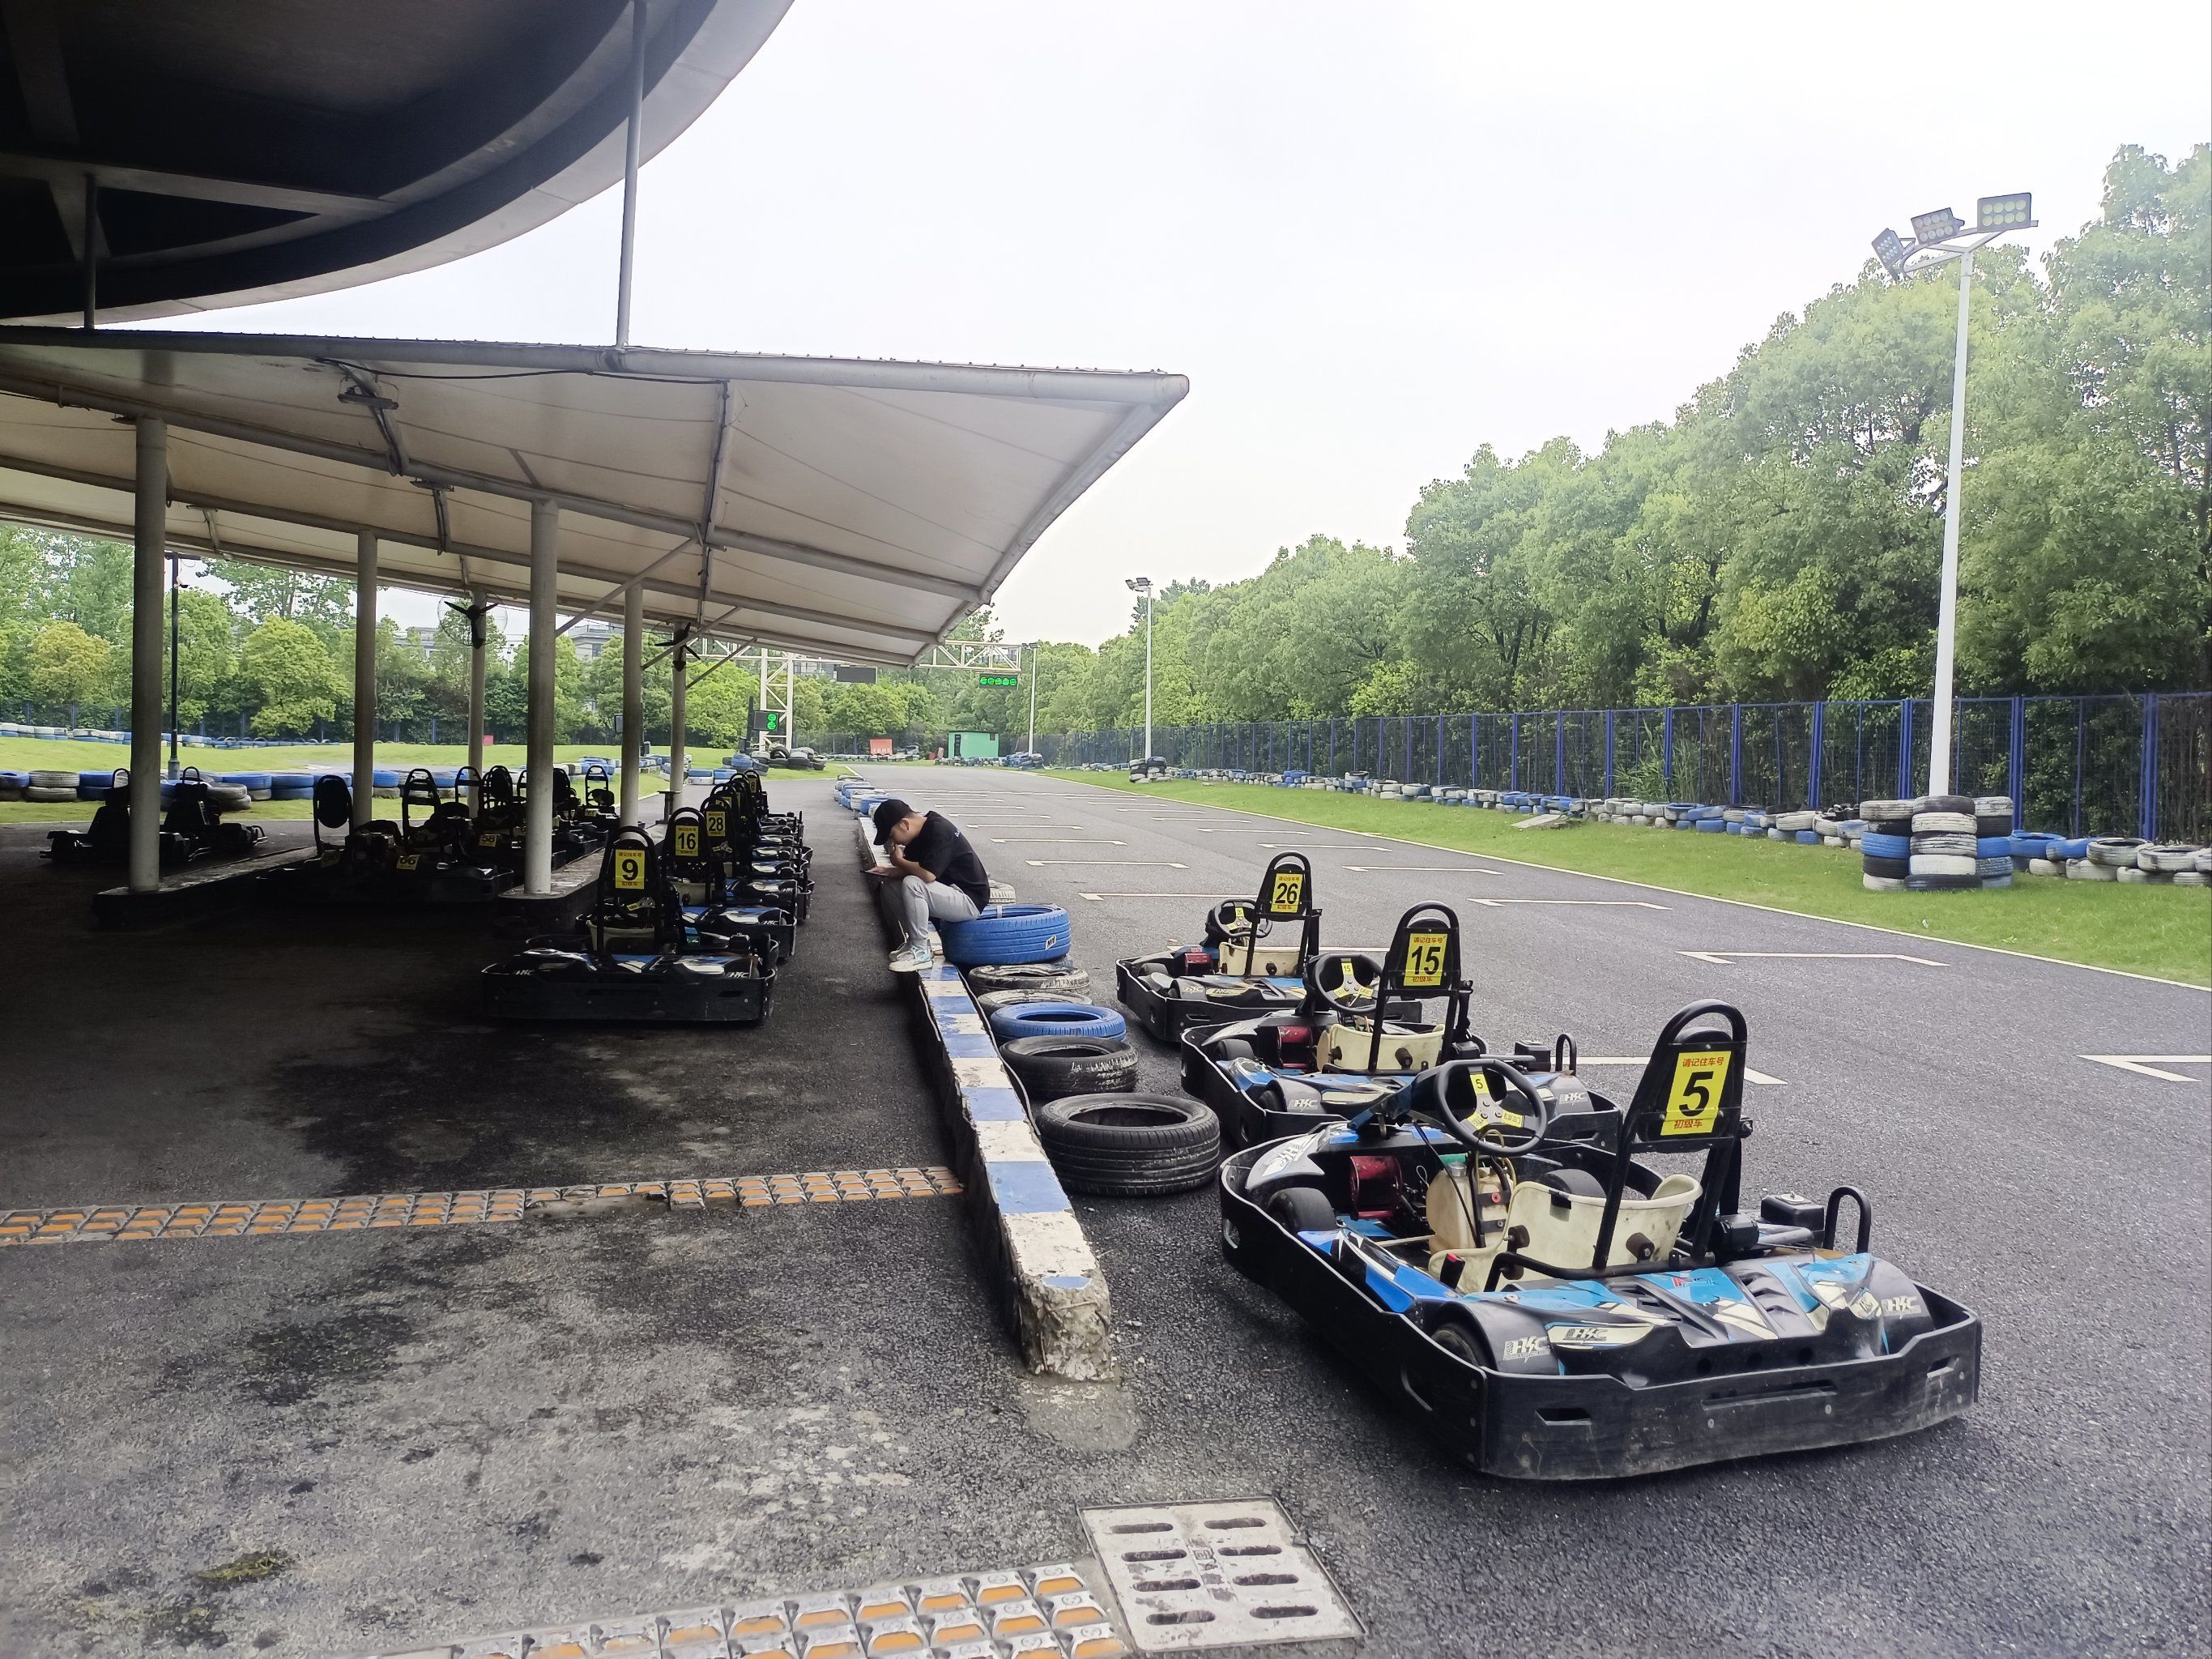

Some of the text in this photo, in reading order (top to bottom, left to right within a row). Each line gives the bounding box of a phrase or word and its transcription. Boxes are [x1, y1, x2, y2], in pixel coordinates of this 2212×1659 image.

[709, 817, 724, 831] 28
[678, 833, 697, 850] 16
[622, 859, 638, 881] 9
[1275, 883, 1298, 904] 26
[1412, 946, 1441, 975] 15
[1682, 1056, 1724, 1068] 请记住车号
[1475, 1078, 1484, 1090] 5
[1678, 1071, 1714, 1117] 5
[1673, 1119, 1703, 1129] 初级车
